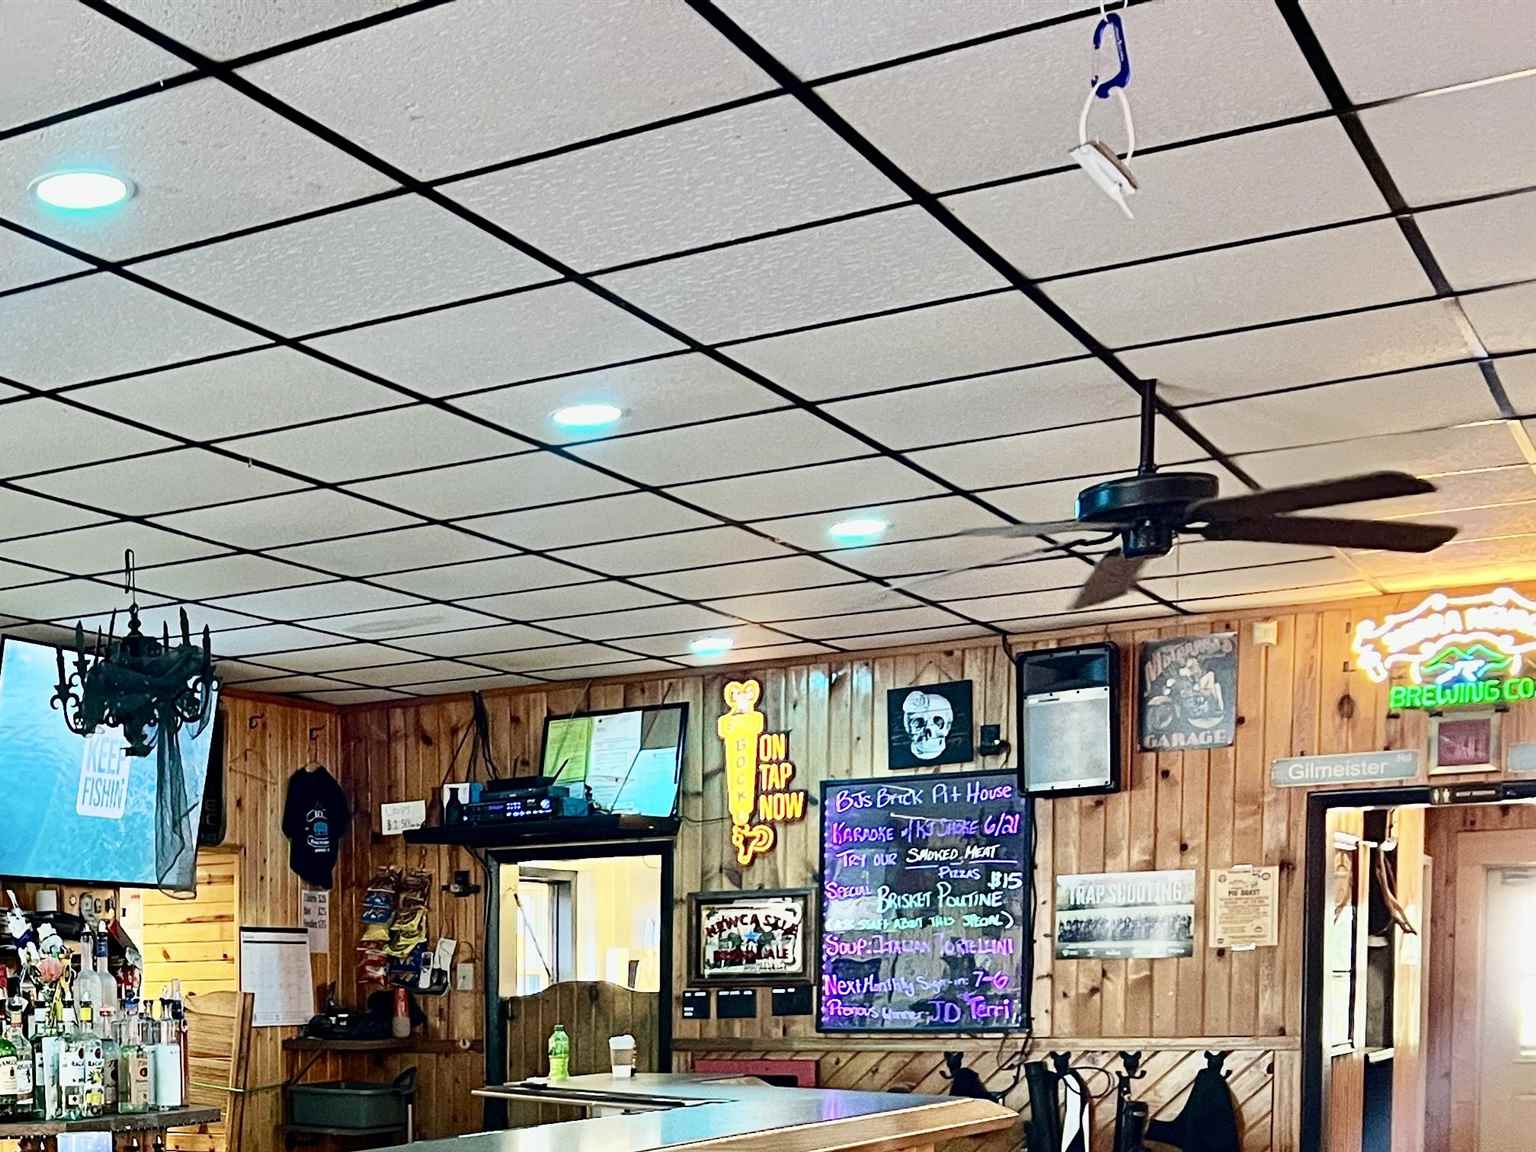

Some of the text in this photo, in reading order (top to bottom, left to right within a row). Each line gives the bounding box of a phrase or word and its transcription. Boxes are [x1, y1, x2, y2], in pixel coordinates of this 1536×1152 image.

[1390, 680, 1501, 709] BREWING
[759, 733, 786, 762] ON
[759, 762, 794, 791] TAP
[1288, 761, 1389, 781] Gilmeister
[759, 792, 805, 821] NOW
[832, 822, 895, 845] KARAOKE
[905, 847, 959, 864] SMOKED
[964, 844, 1001, 860] MEAT
[938, 866, 982, 880] PIZZAS
[987, 872, 1024, 890] $15
[937, 882, 1004, 908] POUTINE
[1069, 885, 1105, 905] TRAP
